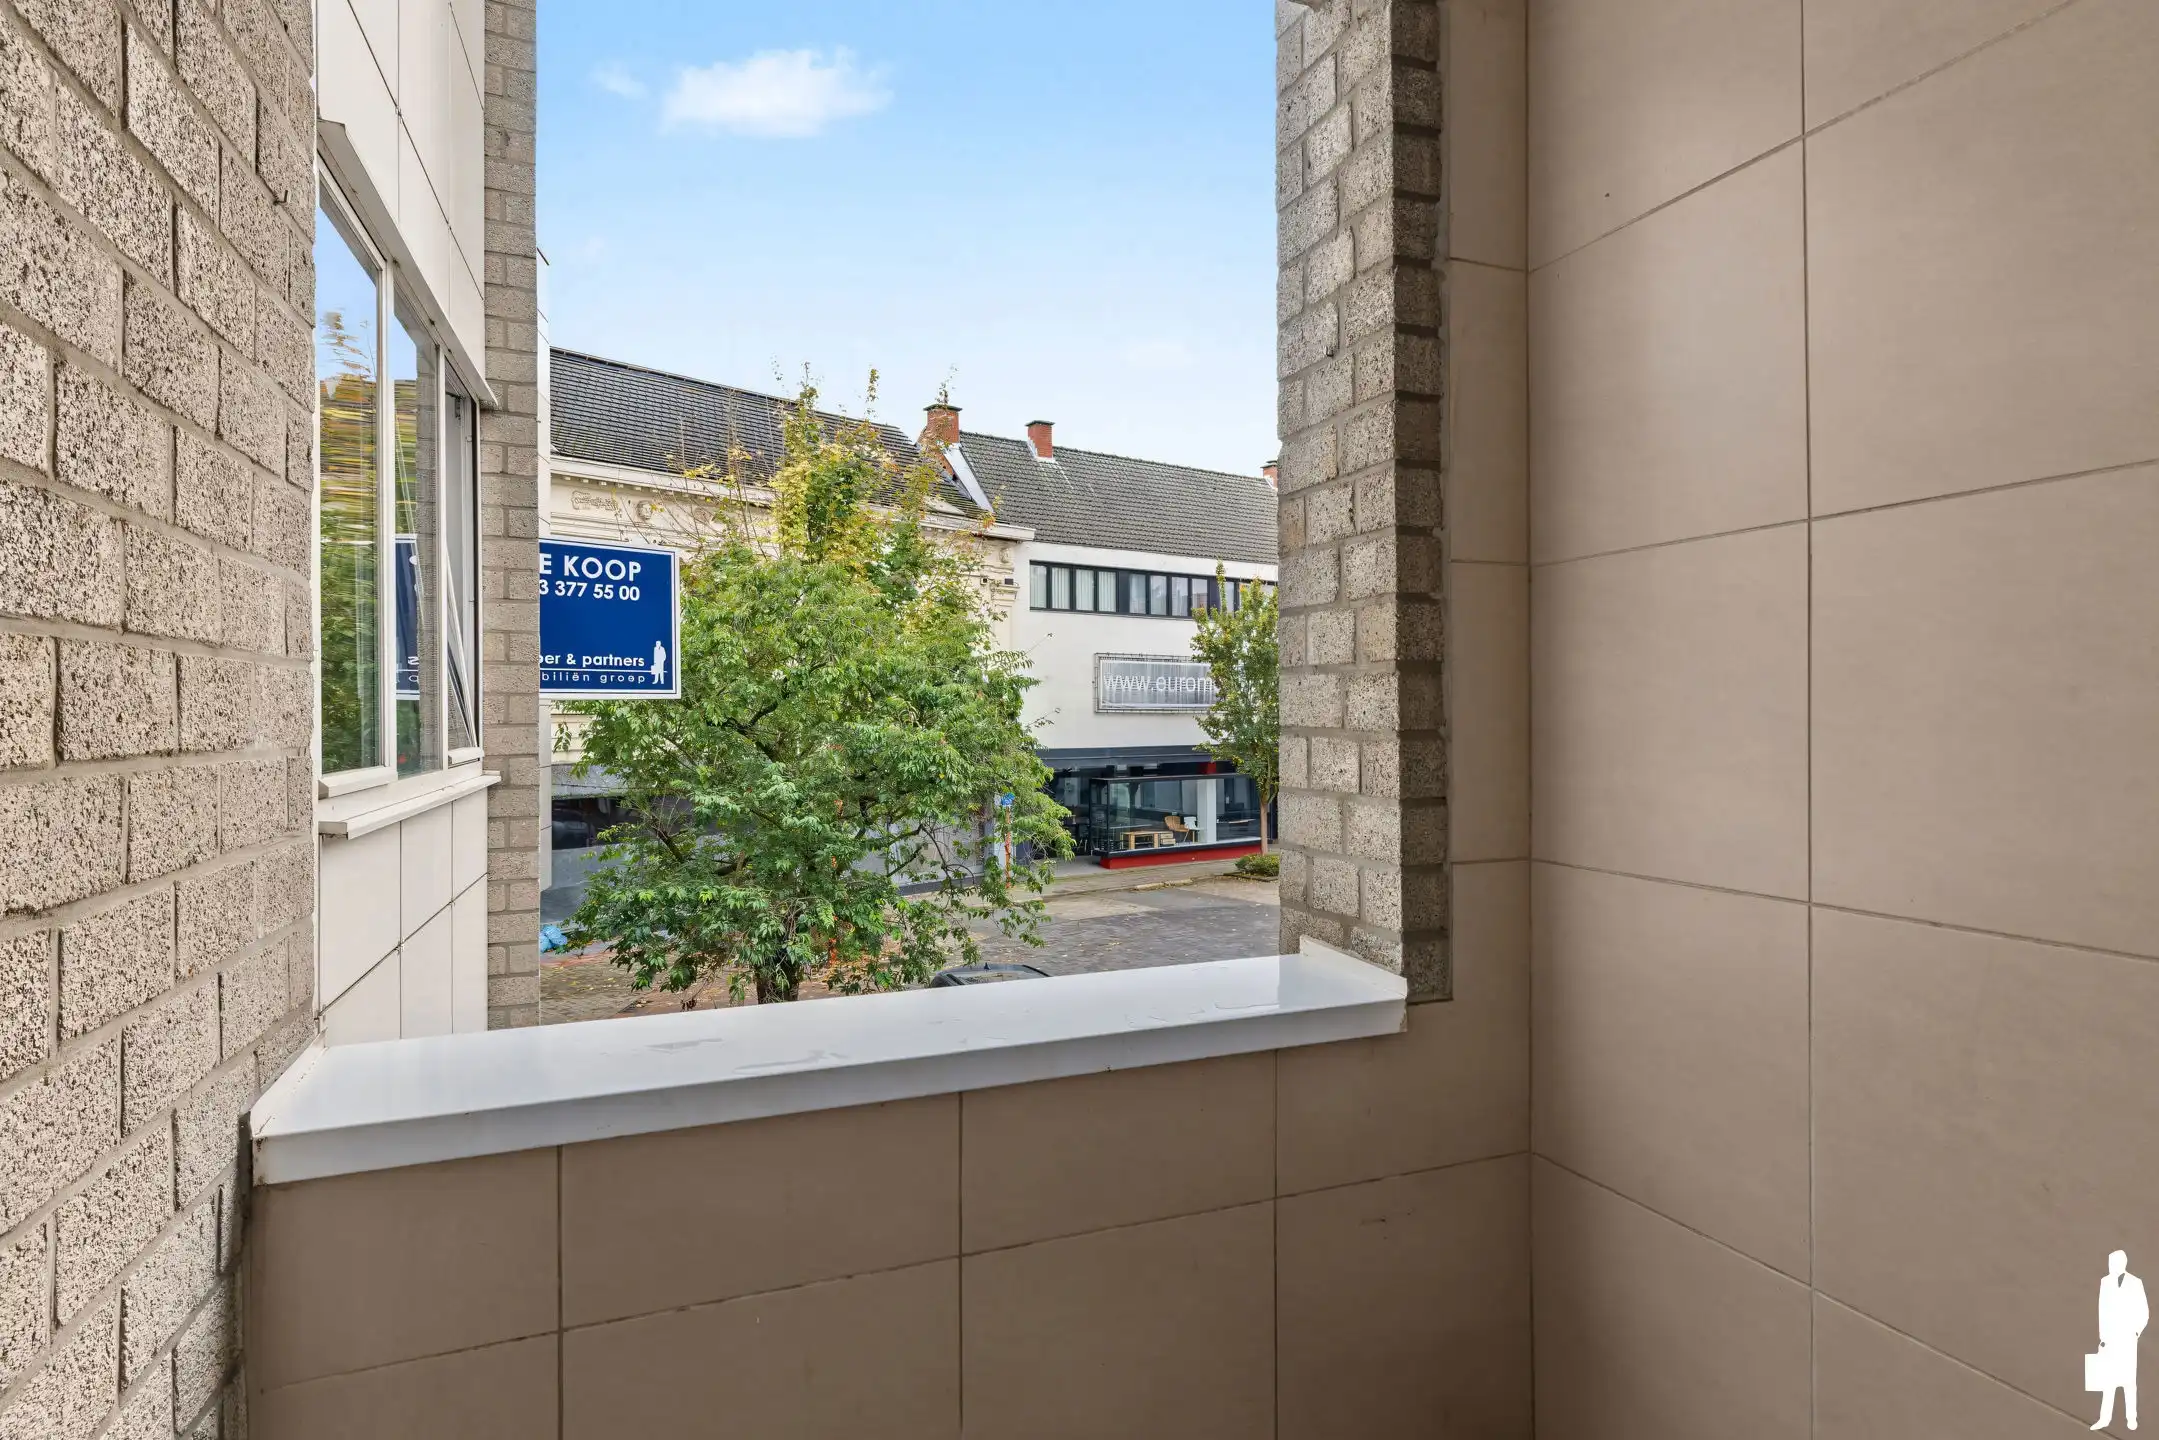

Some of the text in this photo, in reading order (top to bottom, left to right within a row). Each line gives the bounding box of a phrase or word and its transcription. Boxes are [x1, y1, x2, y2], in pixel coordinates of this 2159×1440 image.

[563, 555, 641, 582] KOOP
[555, 581, 588, 597] 377
[593, 583, 614, 600] 55
[618, 586, 641, 601] 00
[566, 653, 576, 665] &
[582, 654, 645, 668] partners
[599, 675, 645, 684] groep
